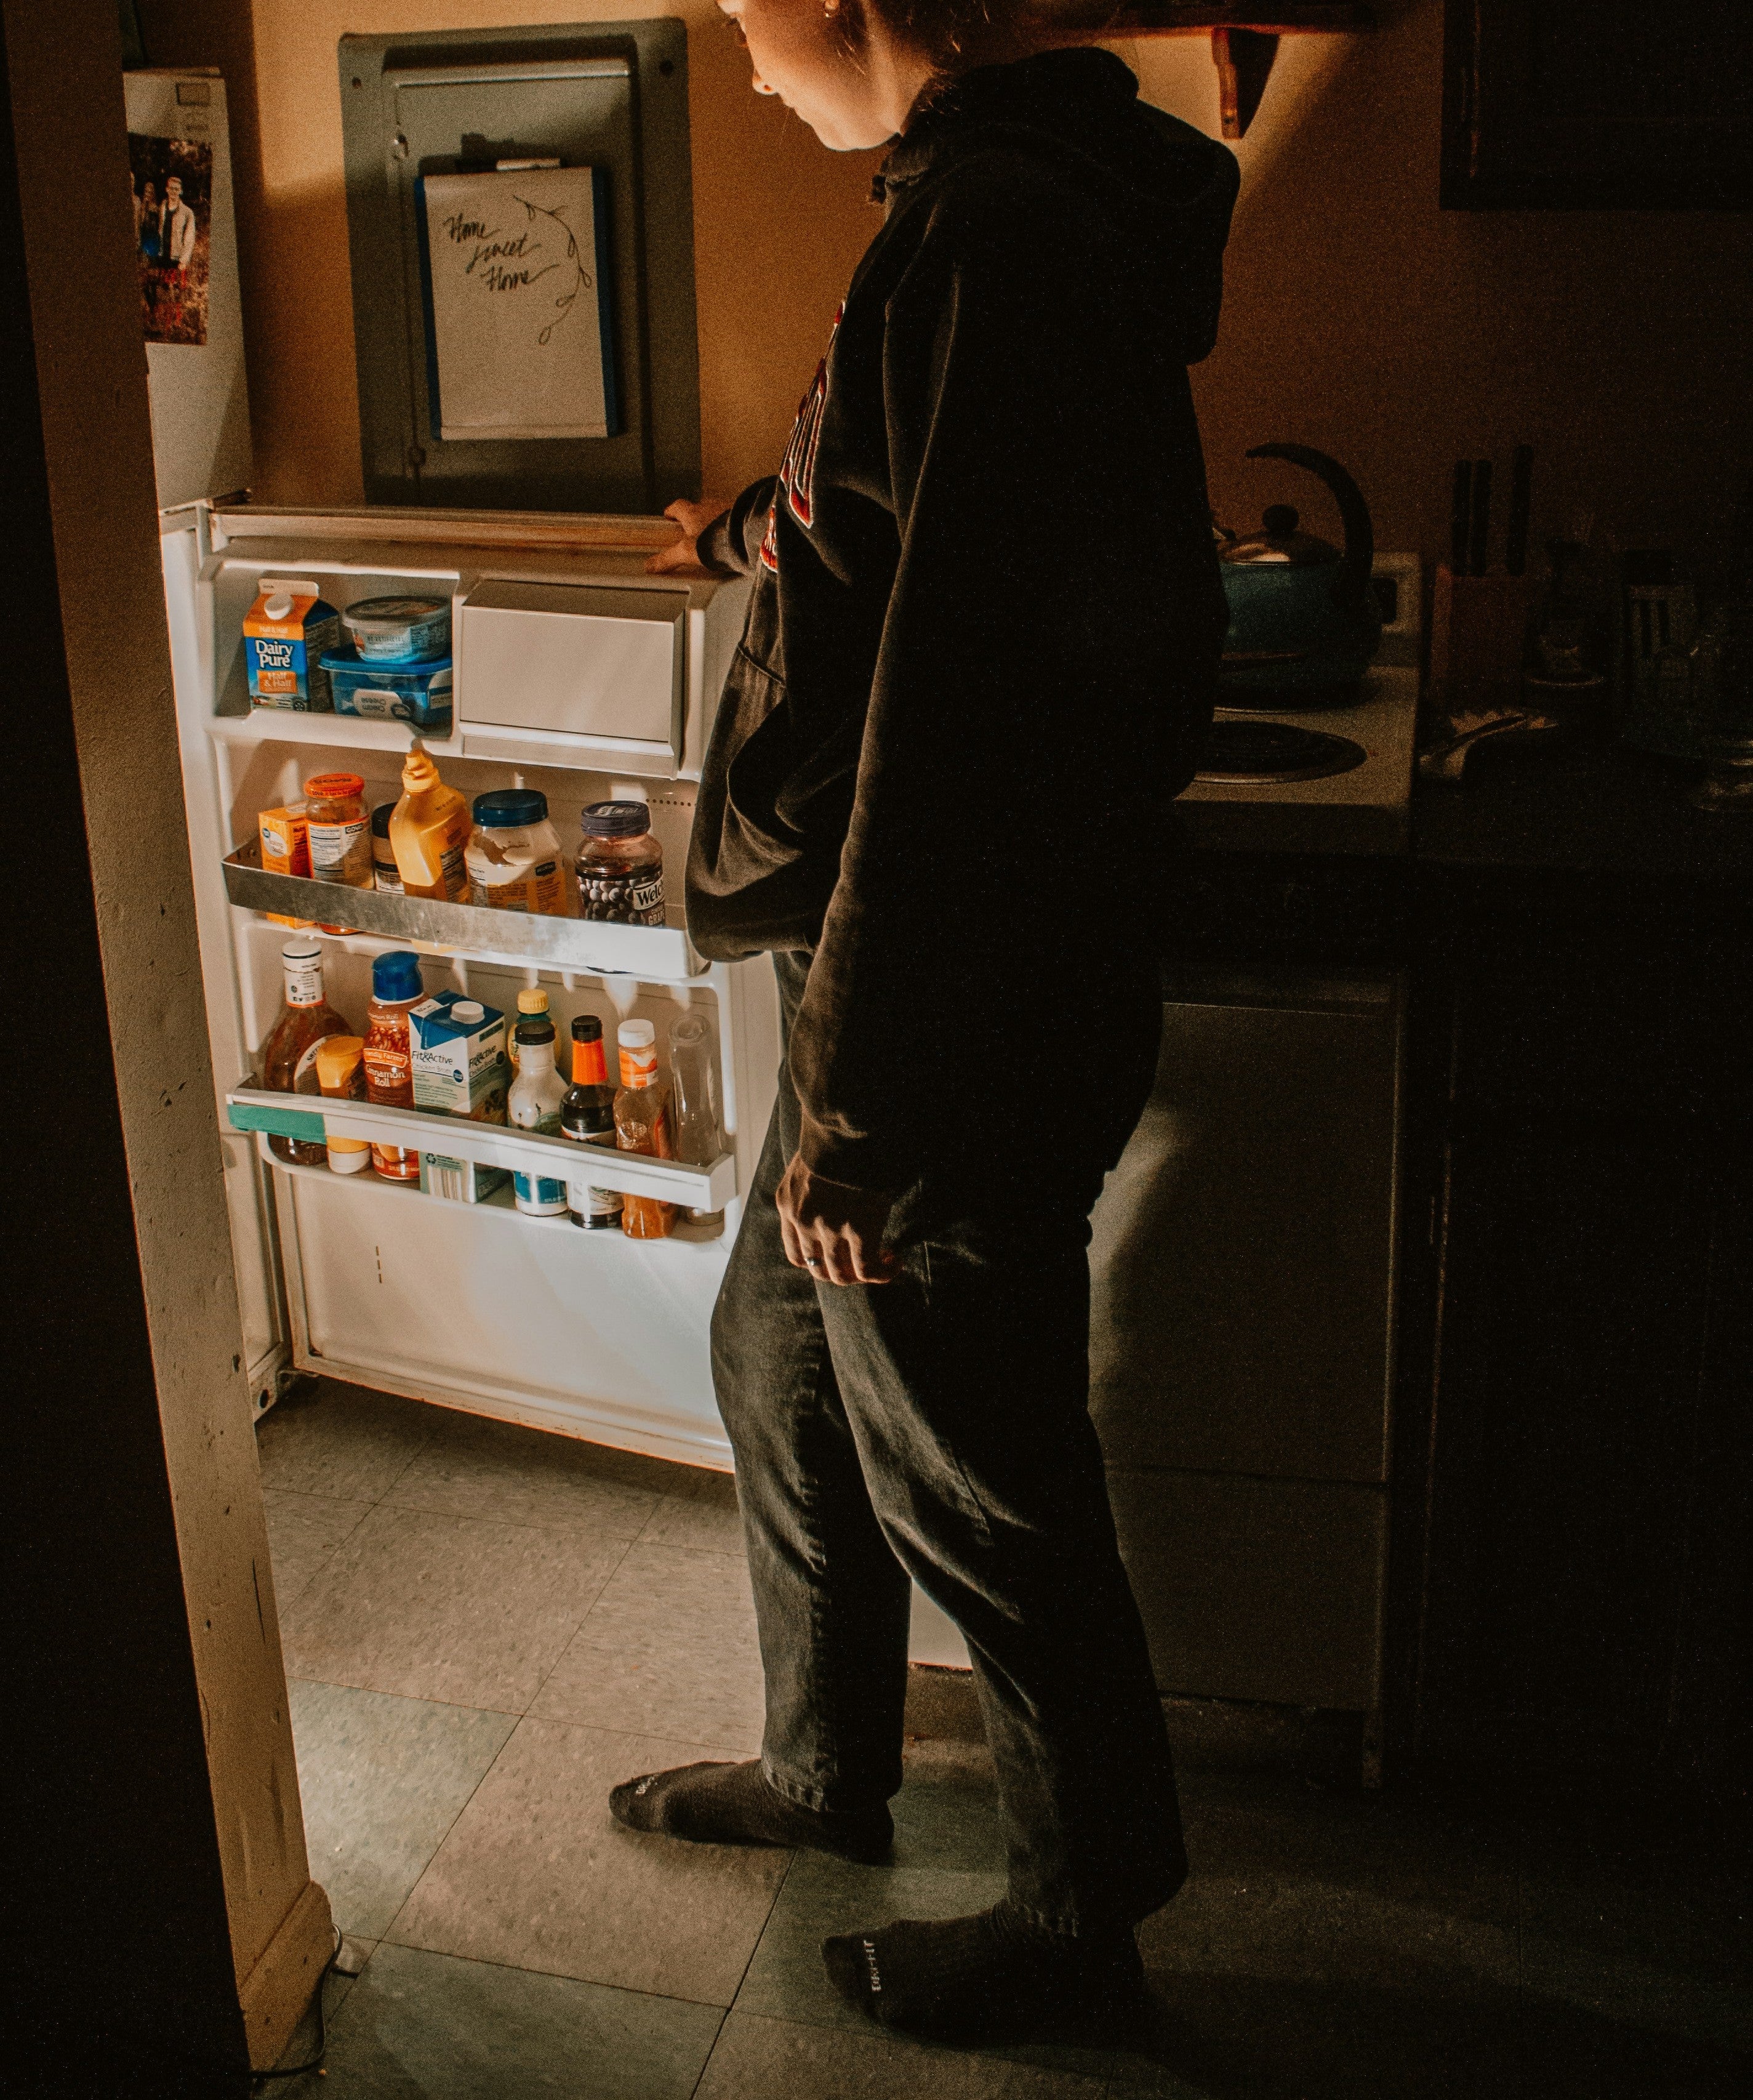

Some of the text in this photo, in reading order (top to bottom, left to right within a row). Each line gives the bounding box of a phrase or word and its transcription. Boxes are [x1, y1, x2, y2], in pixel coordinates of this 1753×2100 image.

[443, 213, 500, 243] Home
[480, 265, 559, 291] Home
[255, 639, 293, 658] Dairy
[259, 654, 291, 668] Pure
[636, 880, 663, 906] Welc
[412, 1050, 454, 1065] Fit&Active
[375, 1076, 391, 1087] Roll
